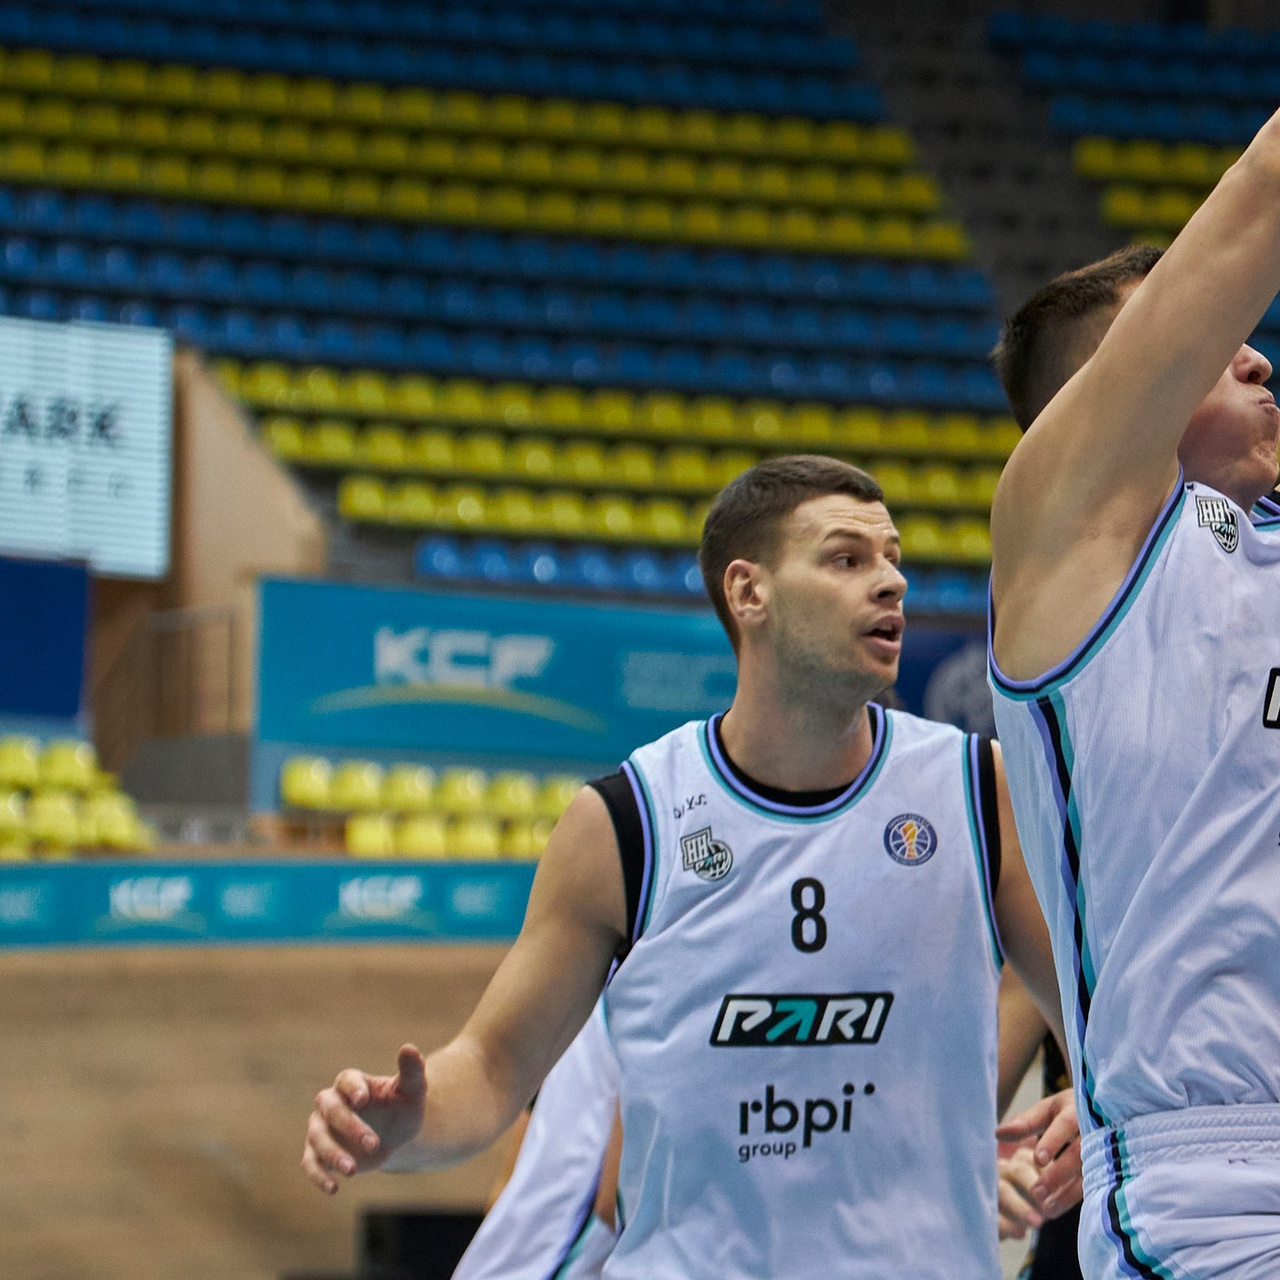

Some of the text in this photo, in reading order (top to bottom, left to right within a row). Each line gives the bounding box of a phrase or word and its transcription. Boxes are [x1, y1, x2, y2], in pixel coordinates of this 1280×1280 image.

[791, 877, 828, 953] 8
[714, 996, 888, 1043] PARI
[738, 1140, 797, 1163] group
